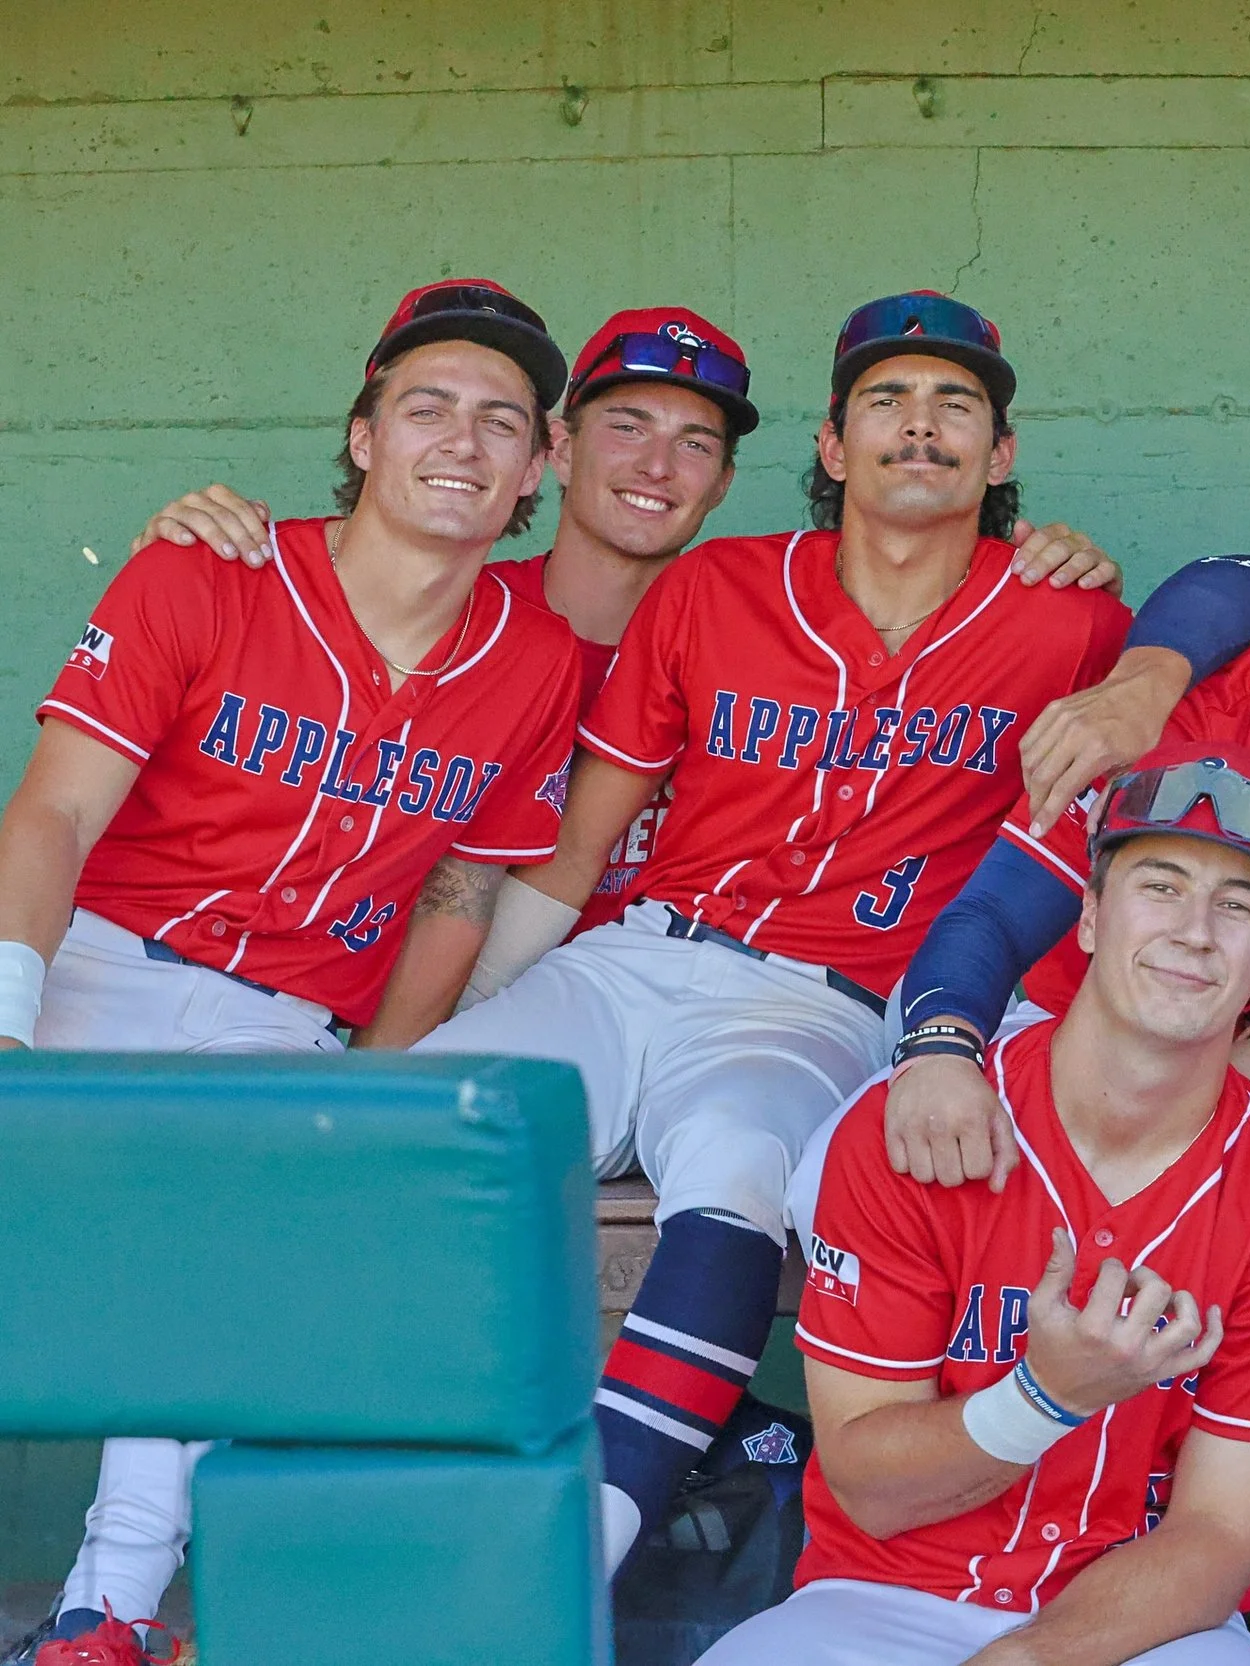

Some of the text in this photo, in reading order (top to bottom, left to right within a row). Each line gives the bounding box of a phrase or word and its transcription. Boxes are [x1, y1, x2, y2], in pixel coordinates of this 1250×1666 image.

[199, 691, 502, 823] APPLESOX
[706, 689, 1017, 775] APPLESOX
[852, 854, 929, 931] 3
